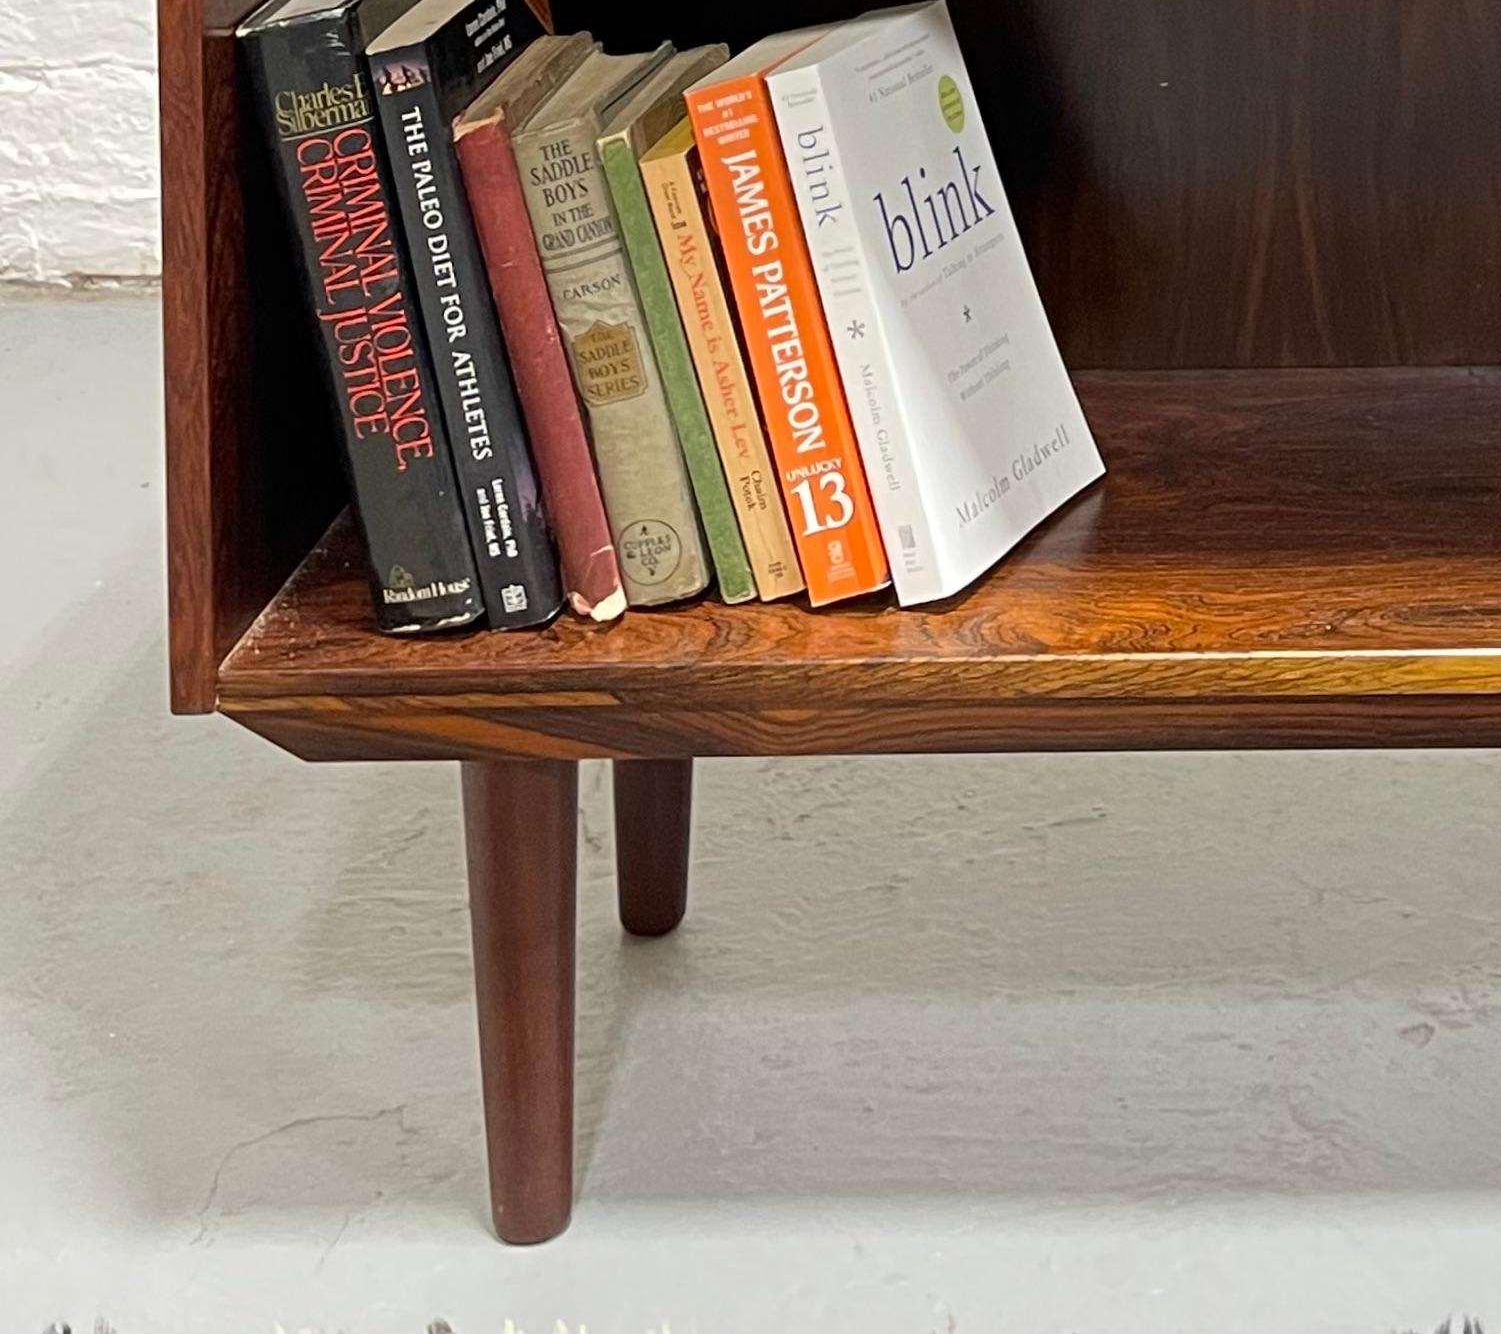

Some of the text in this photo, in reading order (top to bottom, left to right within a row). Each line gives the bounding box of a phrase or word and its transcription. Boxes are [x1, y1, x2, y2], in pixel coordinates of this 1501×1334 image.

[275, 81, 354, 117] Charles
[697, 100, 715, 113] THE
[702, 113, 759, 138] BESTSELLING
[718, 128, 751, 145] WRITER
[540, 138, 573, 162] THE
[530, 151, 594, 187] SADDLE
[797, 123, 844, 228] blink
[542, 177, 589, 208] BOYS
[872, 145, 997, 275] blink
[332, 127, 399, 298] CRIMINAL
[551, 202, 595, 227] IN THE
[542, 218, 614, 252] GRAND CANYON
[296, 137, 391, 440] CRIMINAL JUSTICE
[401, 106, 493, 462] THE PALEO DIET FOR ATHLETES
[562, 274, 623, 301] CARSON
[720, 148, 827, 454] JAMES PATTERSON
[579, 338, 633, 365] SADDLE
[677, 233, 752, 461] My Name is Asher Lev
[587, 375, 641, 398] SERIES
[588, 359, 631, 381] BOYS
[859, 362, 902, 492] Malcolm Gladwell
[785, 457, 844, 483] UNLUCKY
[956, 423, 1071, 530] Malcolm Gladwell
[738, 475, 755, 513] Potok
[750, 468, 767, 512] Chaim
[789, 470, 855, 538] 13
[623, 534, 672, 552] CUPPLES
[639, 544, 672, 559] LEON
